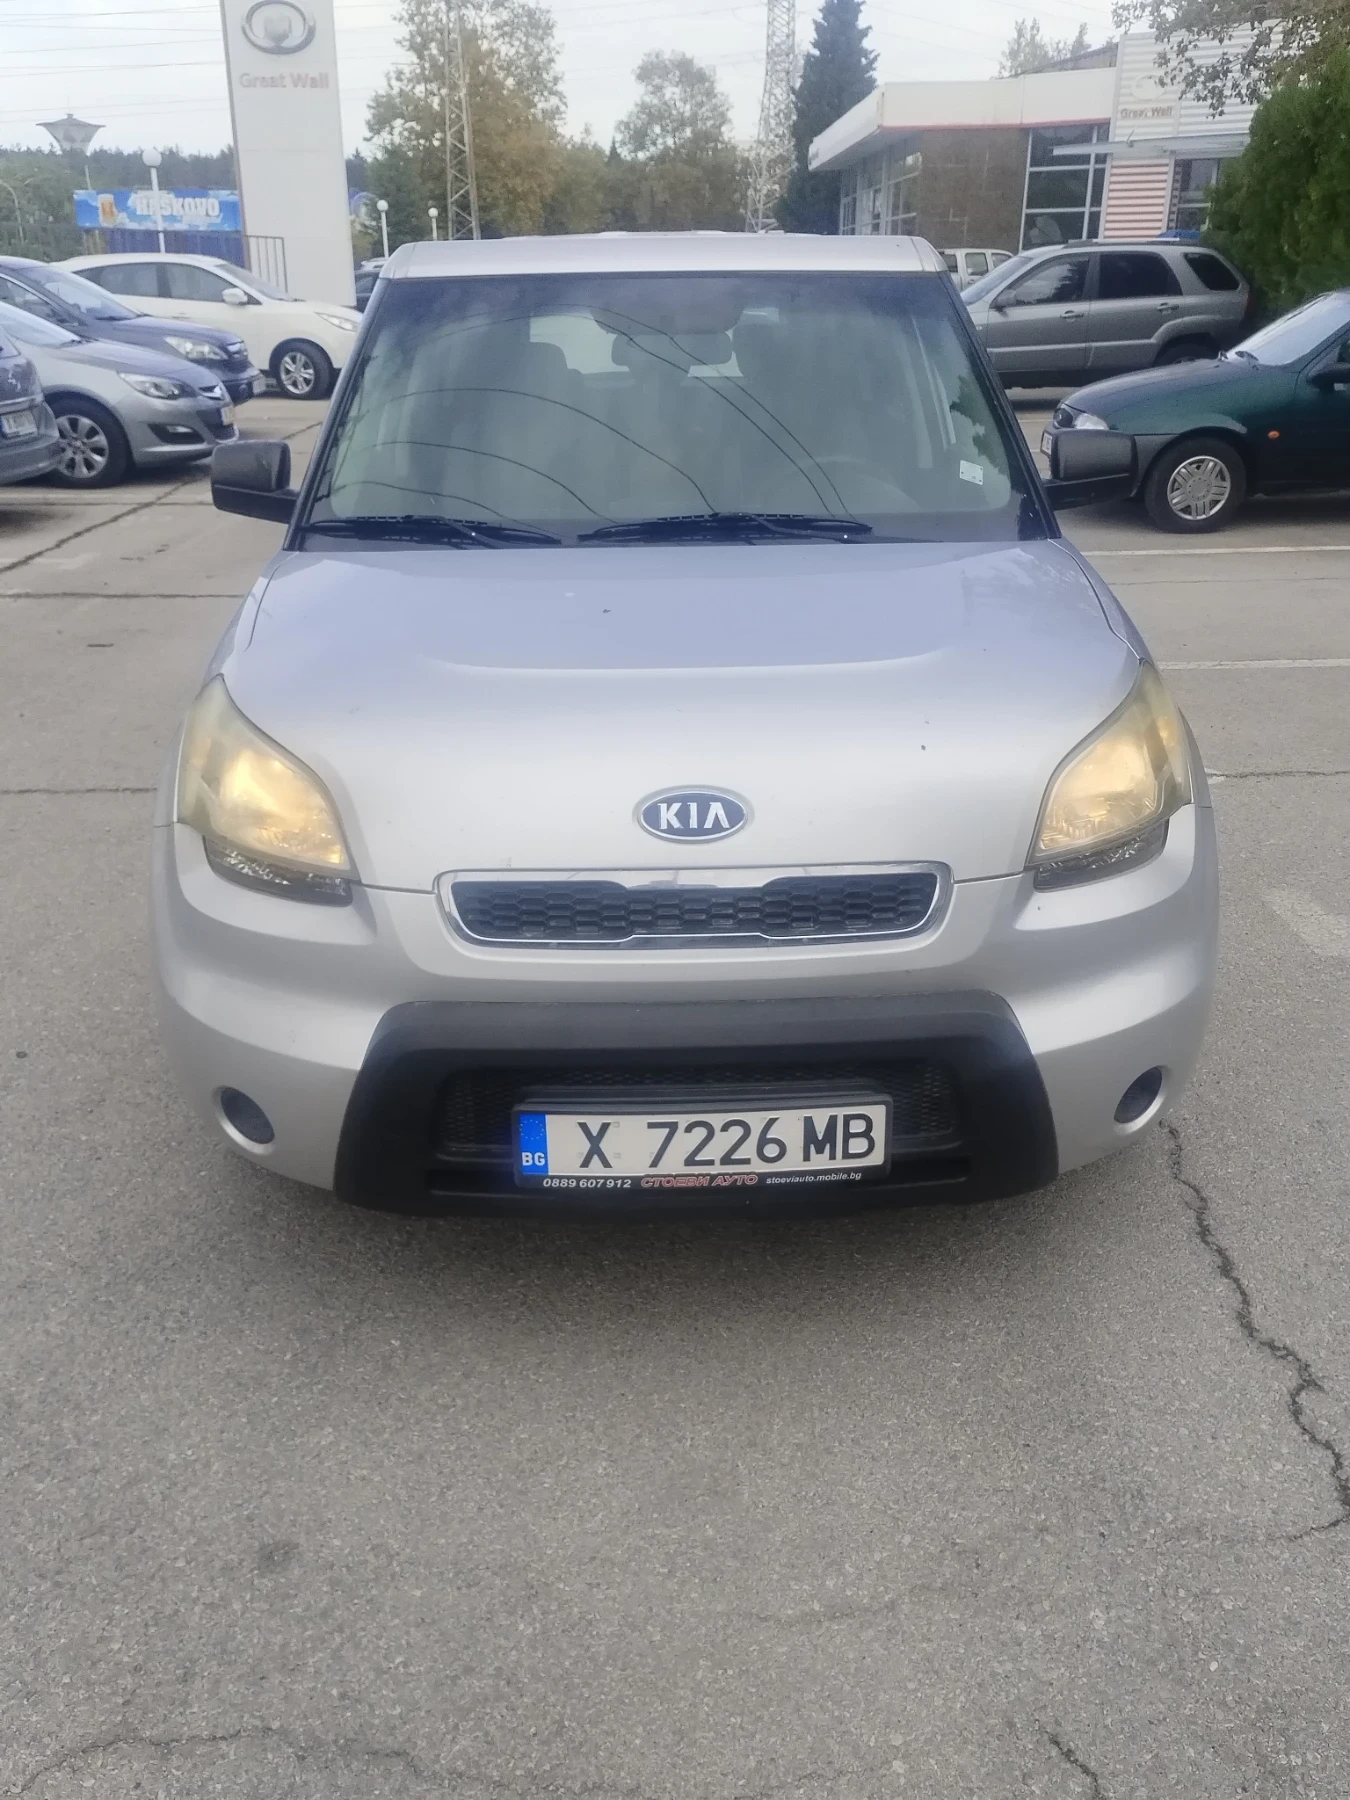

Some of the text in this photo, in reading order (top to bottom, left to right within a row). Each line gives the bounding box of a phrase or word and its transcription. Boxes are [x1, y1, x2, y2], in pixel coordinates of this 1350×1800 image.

[240, 72, 329, 89] Great Wall
[657, 801, 731, 829] KIA
[576, 1112, 876, 1169] X 7226 MB
[521, 1151, 546, 1166] BG
[543, 1178, 632, 1188] 0889 607 912
[711, 1174, 759, 1187] АУТО
[765, 1171, 863, 1185] stoeviauto.mobile.bg
